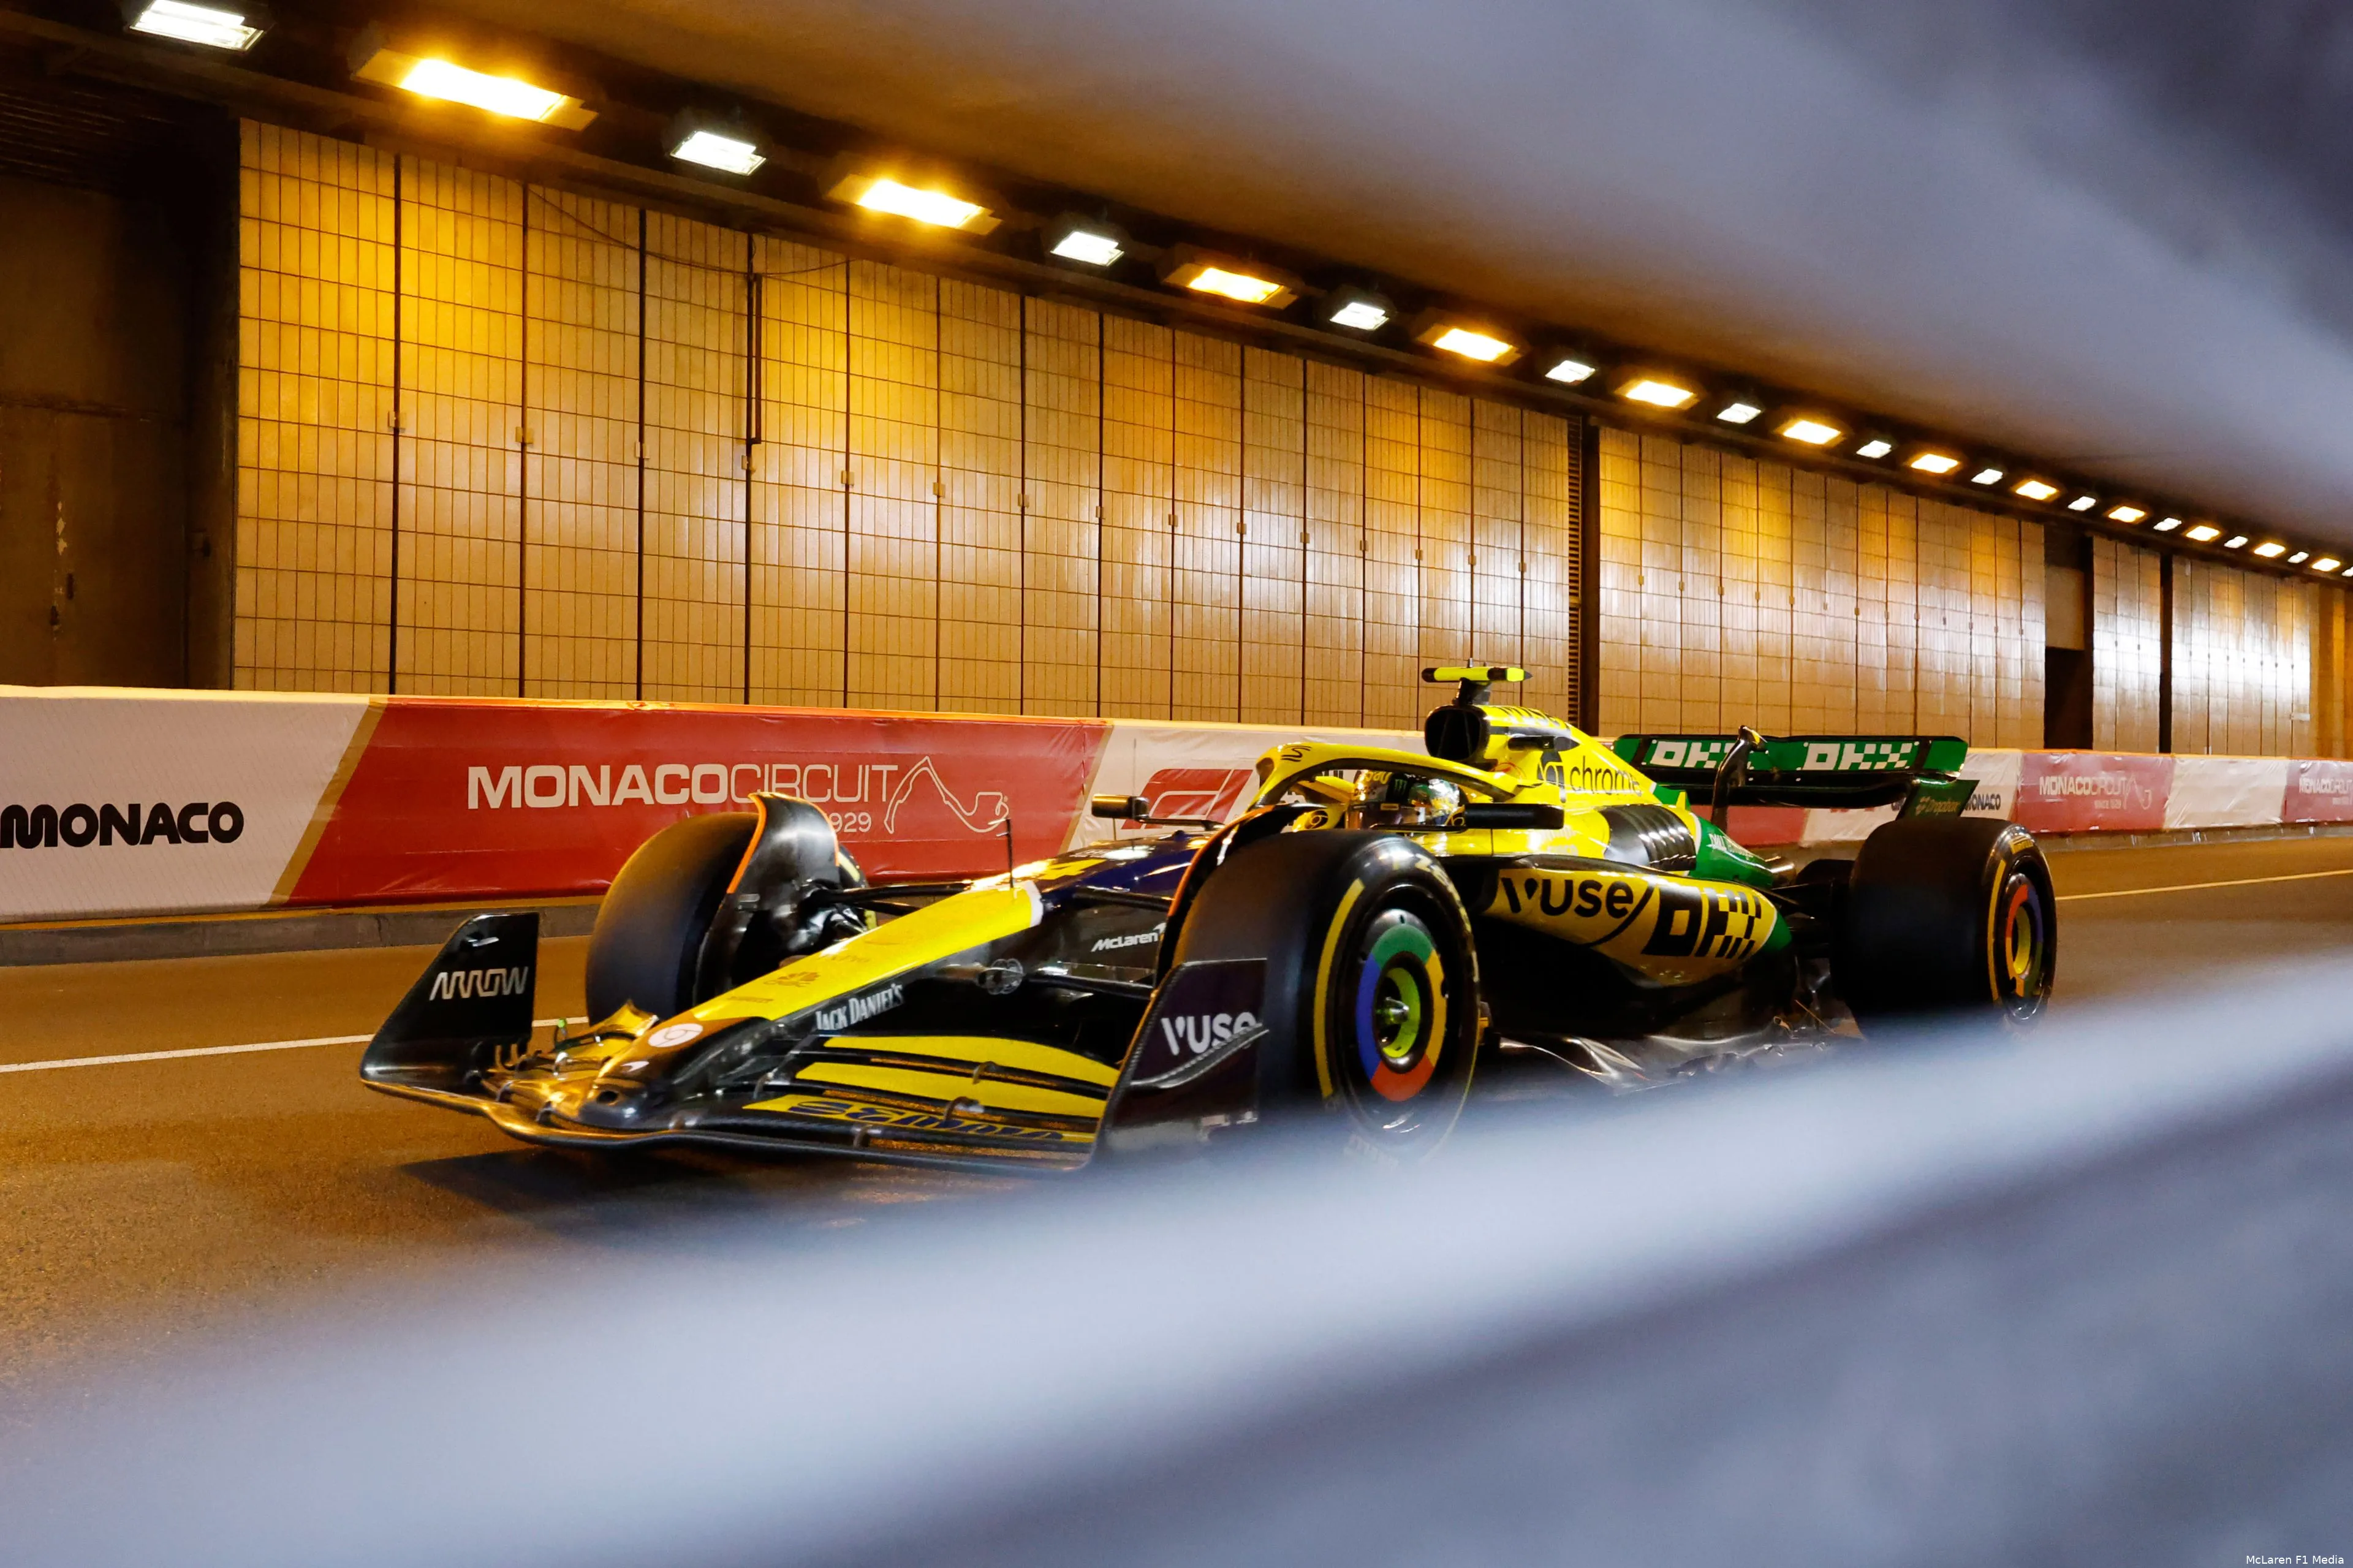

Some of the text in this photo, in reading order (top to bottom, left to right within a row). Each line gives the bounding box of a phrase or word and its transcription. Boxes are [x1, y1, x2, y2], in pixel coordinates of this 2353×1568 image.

[1570, 756, 1642, 797] chrome
[0, 801, 244, 849] MONACO
[1091, 931, 1159, 952] McLaren
[430, 966, 529, 1001] ARROW
